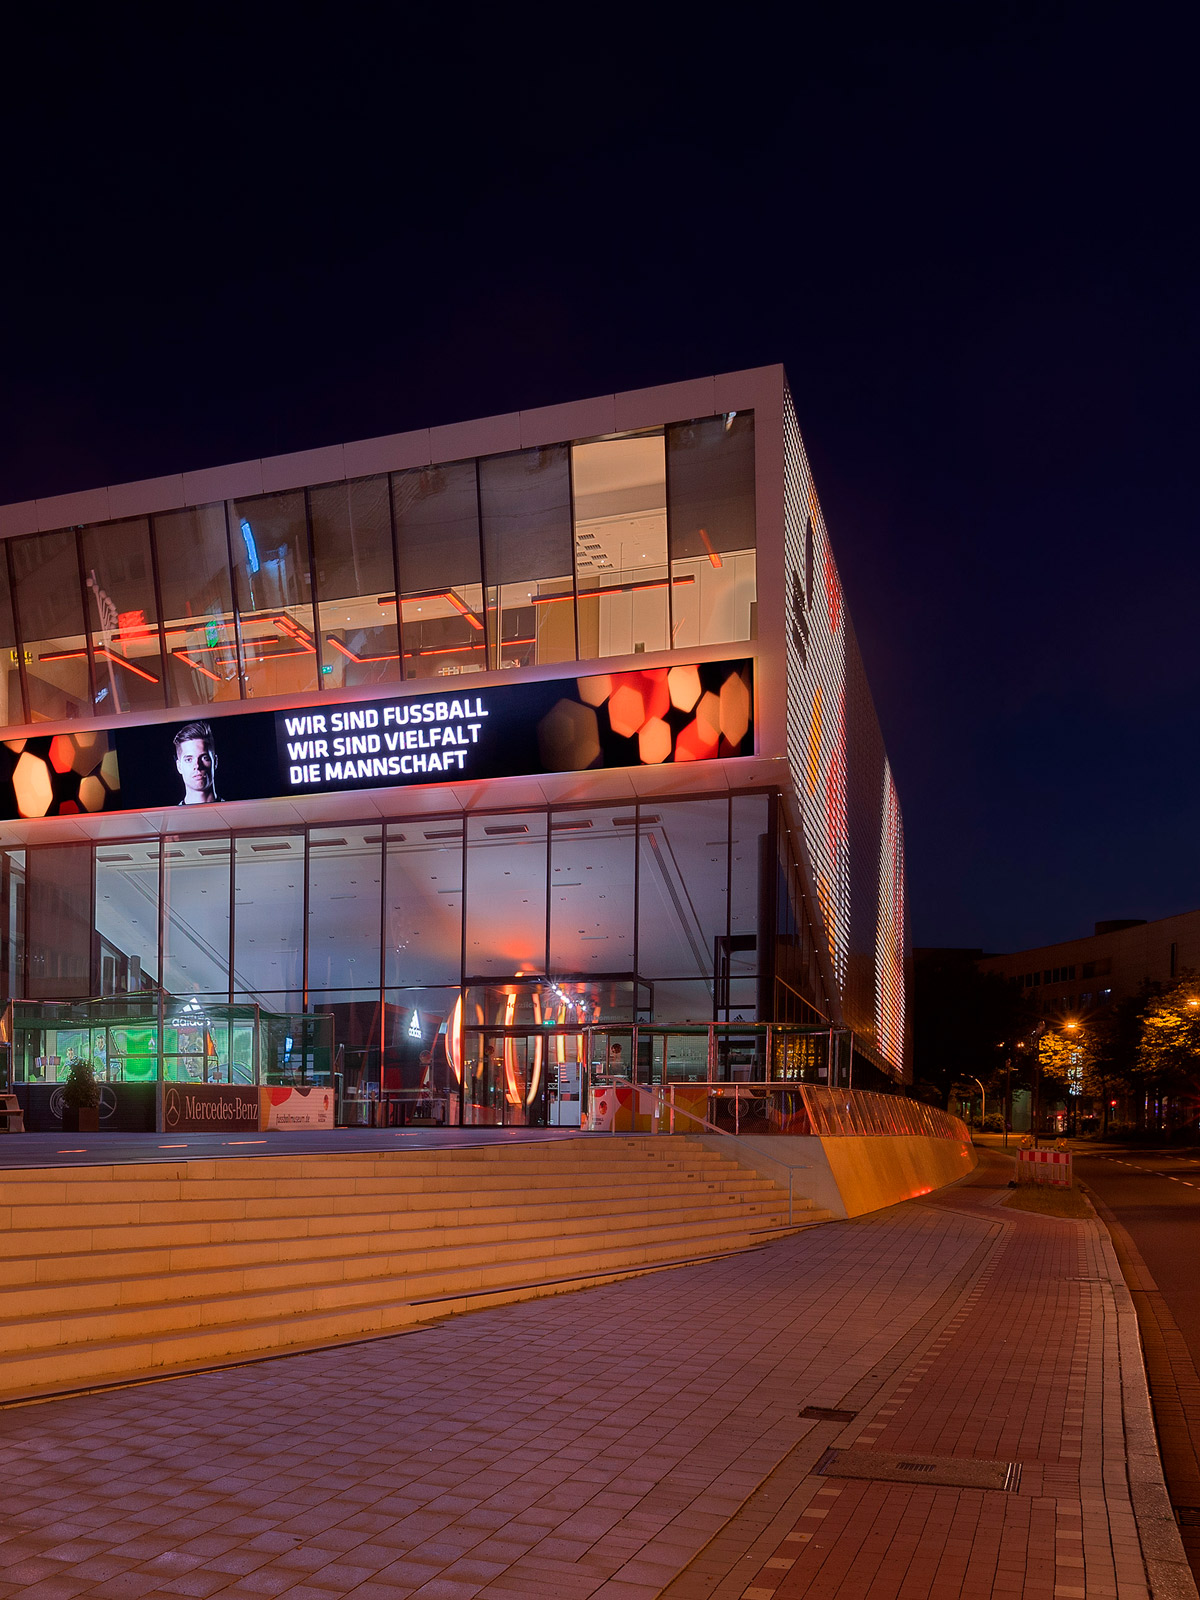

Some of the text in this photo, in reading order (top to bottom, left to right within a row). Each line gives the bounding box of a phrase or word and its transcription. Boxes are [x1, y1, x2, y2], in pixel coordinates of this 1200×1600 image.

[285, 697, 489, 736] WIR SIND FUSSBALL
[286, 723, 482, 761] WIR SIND VIELFALT
[289, 749, 468, 785] DIE MANNSCHAFT
[184, 1095, 258, 1121] Mercedes-Benz
